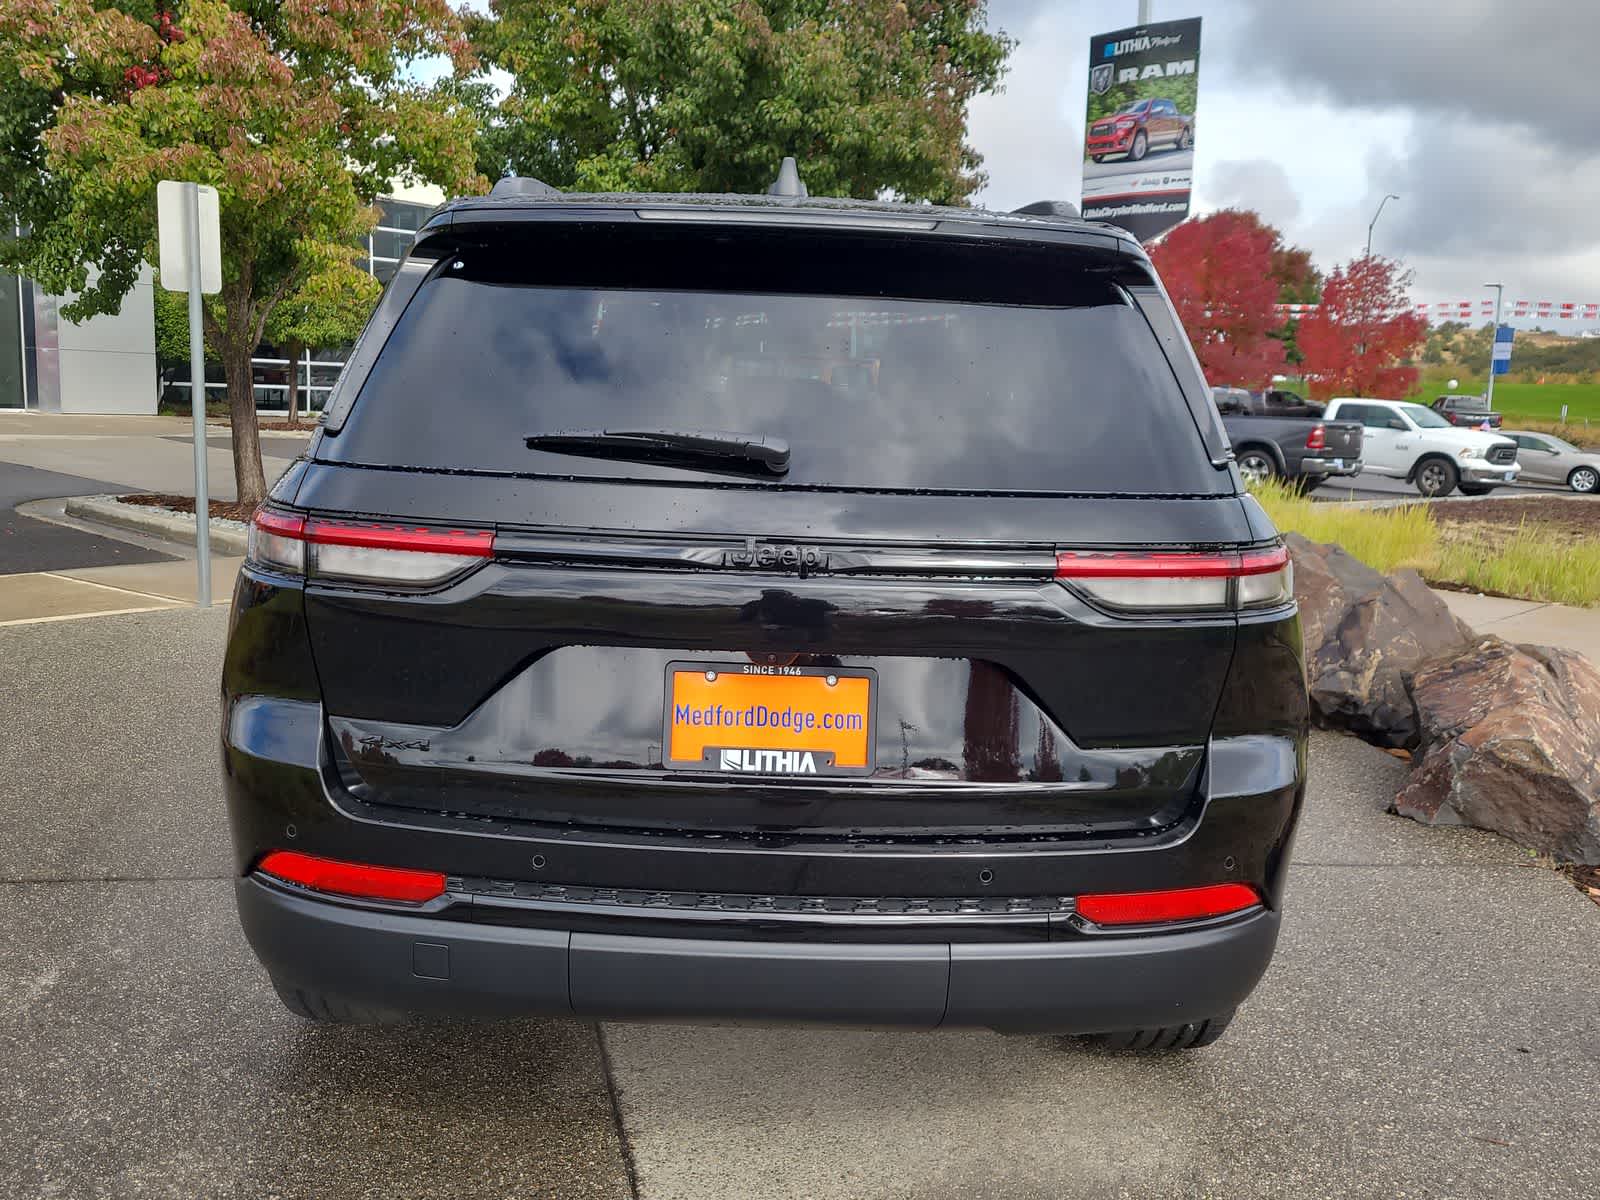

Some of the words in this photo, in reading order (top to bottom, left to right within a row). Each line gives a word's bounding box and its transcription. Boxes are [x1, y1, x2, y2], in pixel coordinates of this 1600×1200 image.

[1113, 36, 1152, 56] LITHIA
[1118, 59, 1196, 84] RAM
[730, 535, 824, 579] Jeep
[743, 664, 775, 675] SINCE
[777, 666, 802, 676] 1946
[674, 703, 863, 734] MedfordDodge.com
[742, 749, 817, 773] LITHIA
